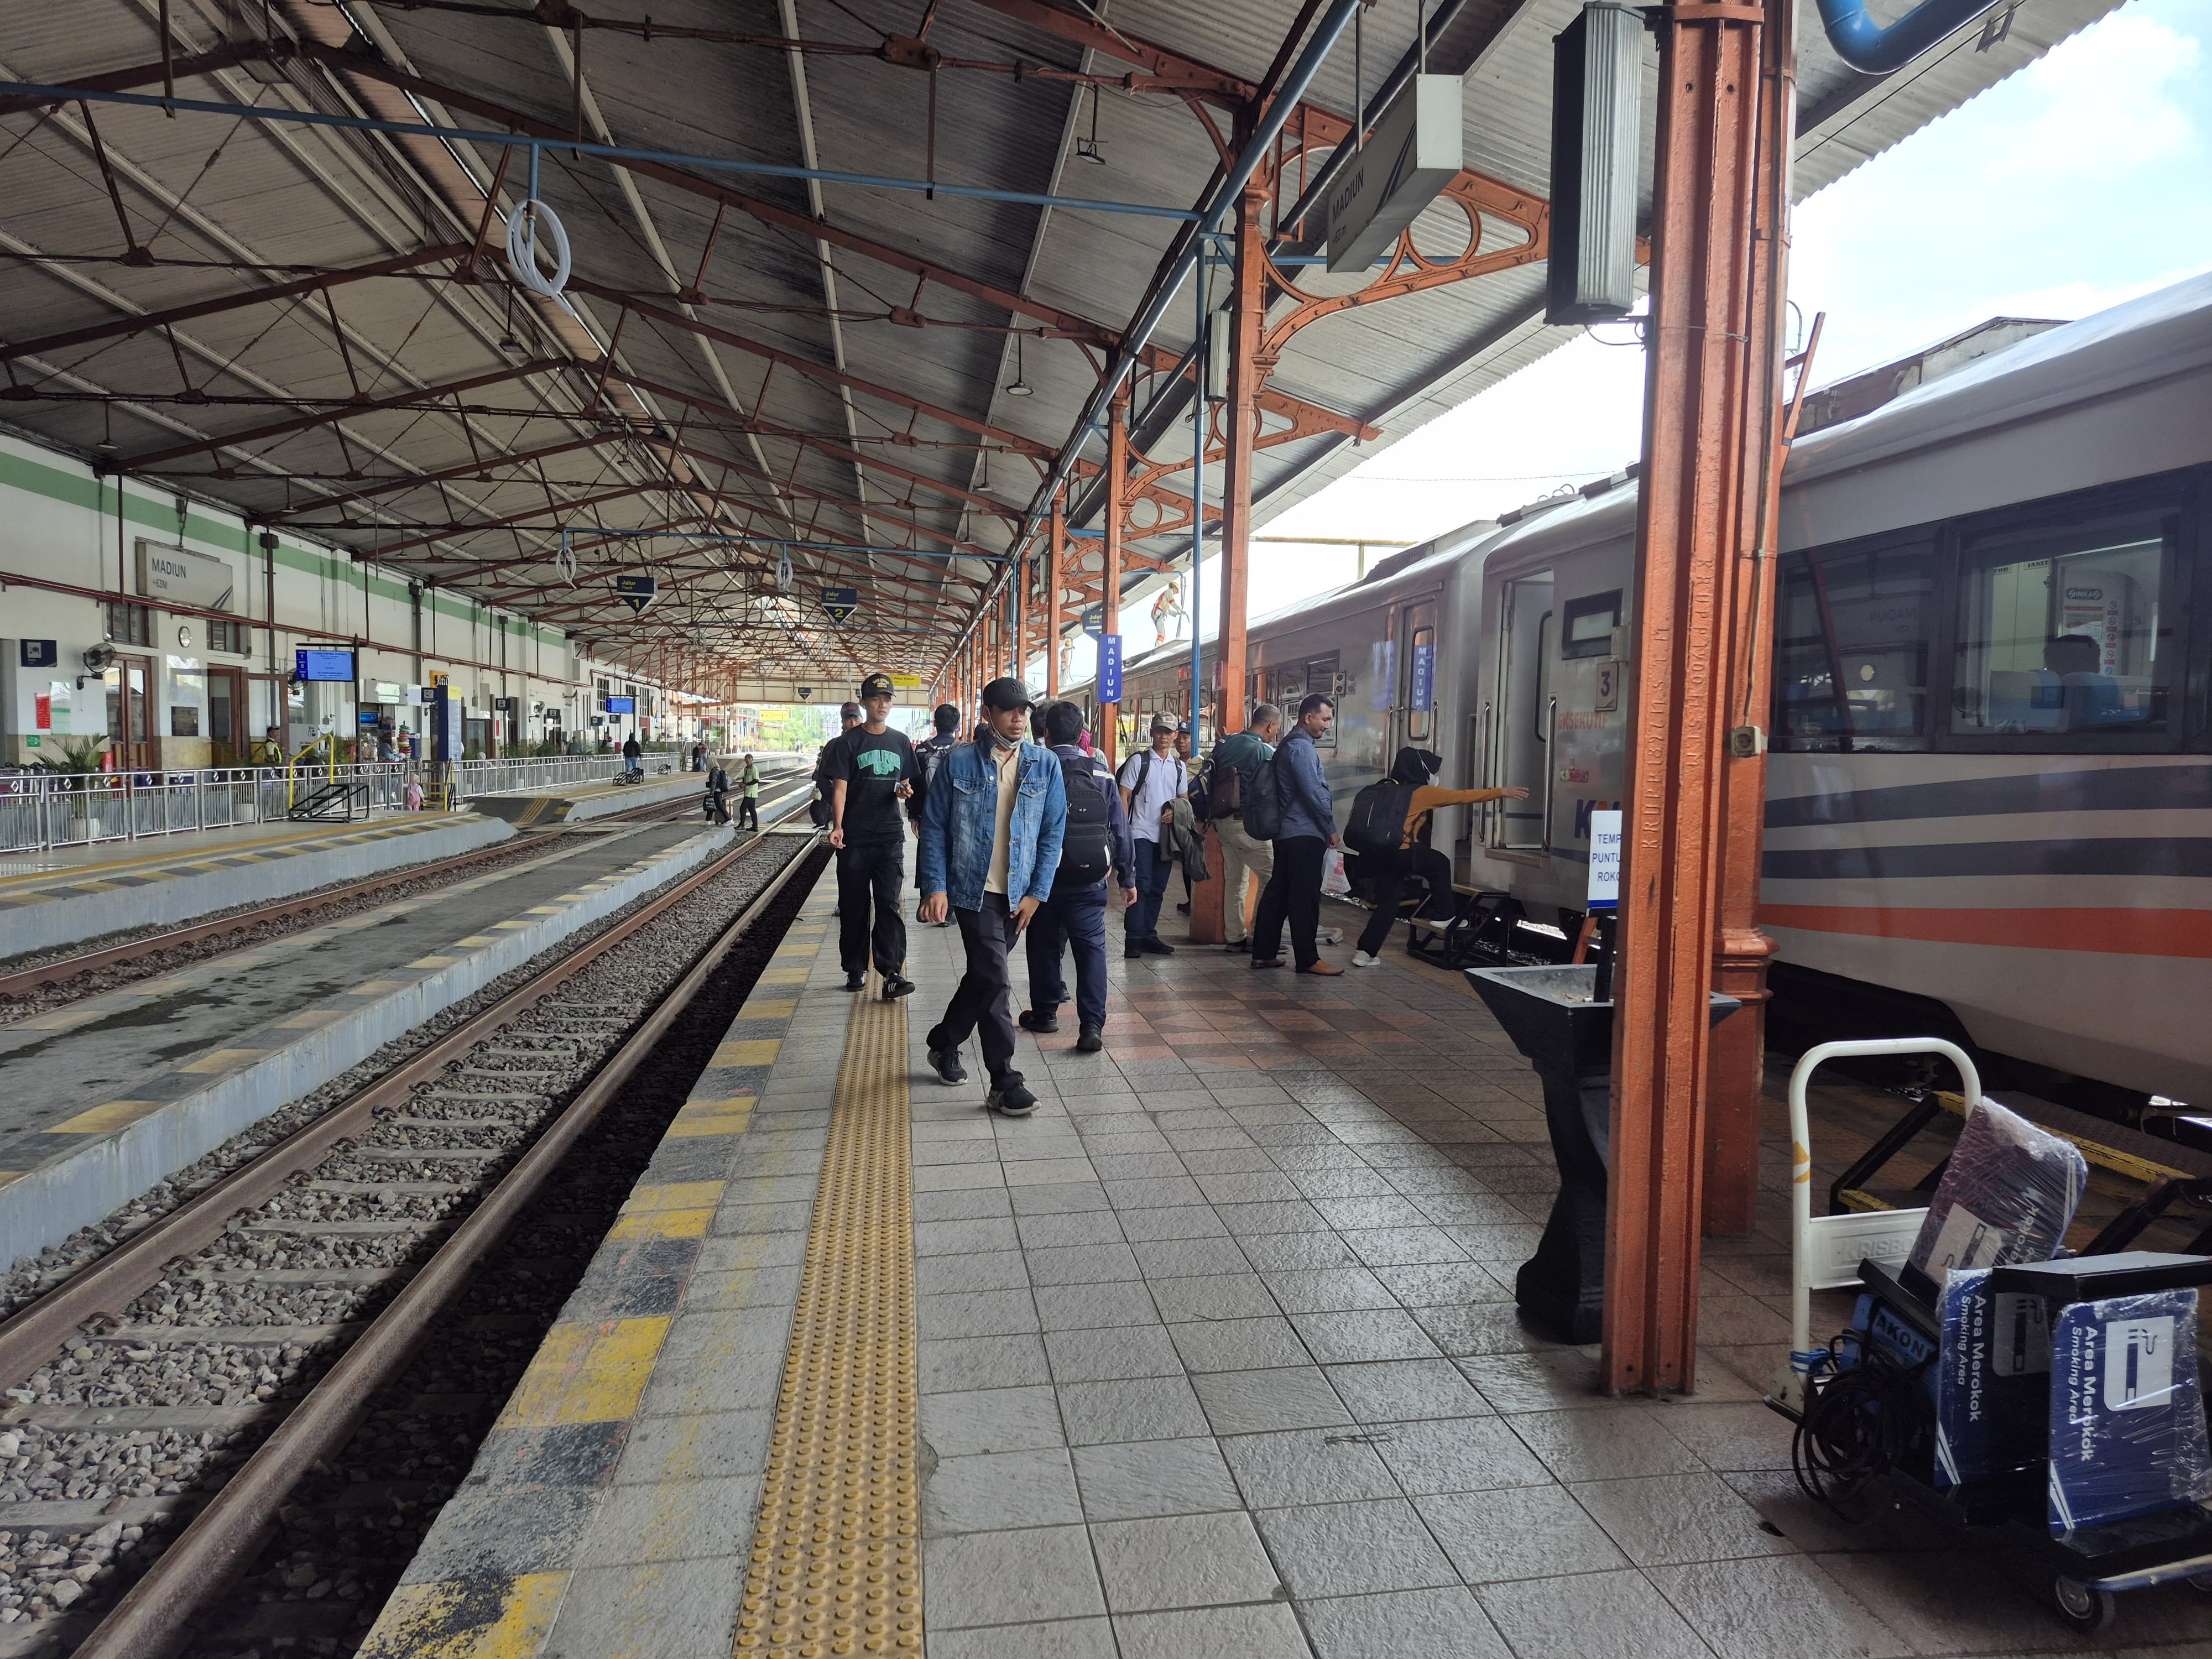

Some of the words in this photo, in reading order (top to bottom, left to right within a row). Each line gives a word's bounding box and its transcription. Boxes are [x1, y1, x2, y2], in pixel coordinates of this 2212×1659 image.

[152, 558, 187, 579] MADIUN
[633, 598, 640, 608] 1
[834, 608, 844, 618] 2
[1106, 637, 1116, 697] MADIUN
[1600, 671, 1611, 697] 3
[1958, 1296, 1971, 1351] Smoking
[1973, 1295, 1987, 1337] Area
[2068, 1327, 2082, 1386] Smoking
[2084, 1326, 2098, 1370] Area
[1958, 1354, 1969, 1385] Area
[1970, 1343, 1985, 1422] Merokok
[2068, 1390, 2080, 1424] Area
[2081, 1376, 2097, 1461] Merokok
